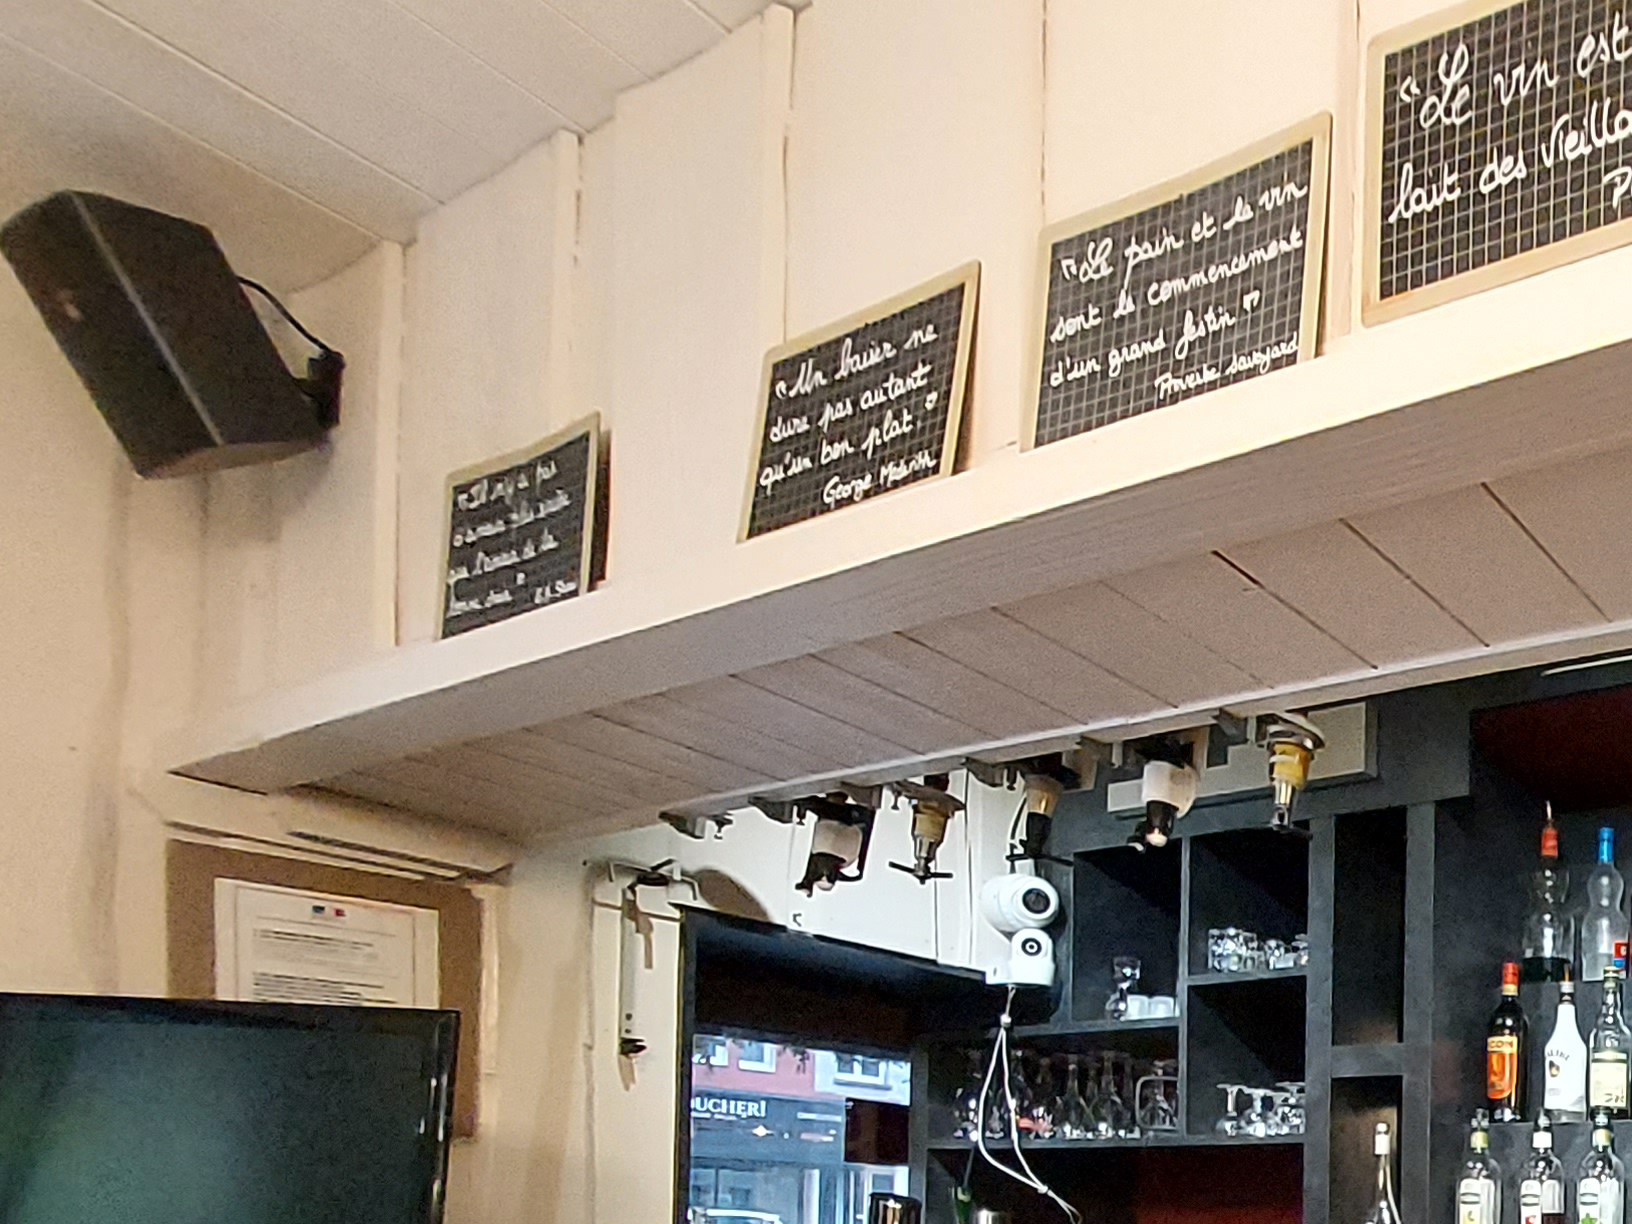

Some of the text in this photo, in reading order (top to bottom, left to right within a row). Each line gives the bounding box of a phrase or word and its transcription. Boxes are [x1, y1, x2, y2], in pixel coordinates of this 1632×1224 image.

[1492, 58, 1560, 108] vin
[1388, 165, 1464, 223] lait
[1478, 142, 1528, 197] des
[1124, 227, 1185, 291] pain
[1191, 210, 1218, 242] et
[1222, 195, 1255, 231] le
[1258, 178, 1309, 212] vin
[1050, 223, 1304, 344] sont le commencement
[903, 323, 939, 350] ne
[1050, 358, 1102, 388] d'un
[1107, 329, 1168, 377] grand
[768, 361, 933, 444] dure pas autant
[819, 438, 856, 466] bon
